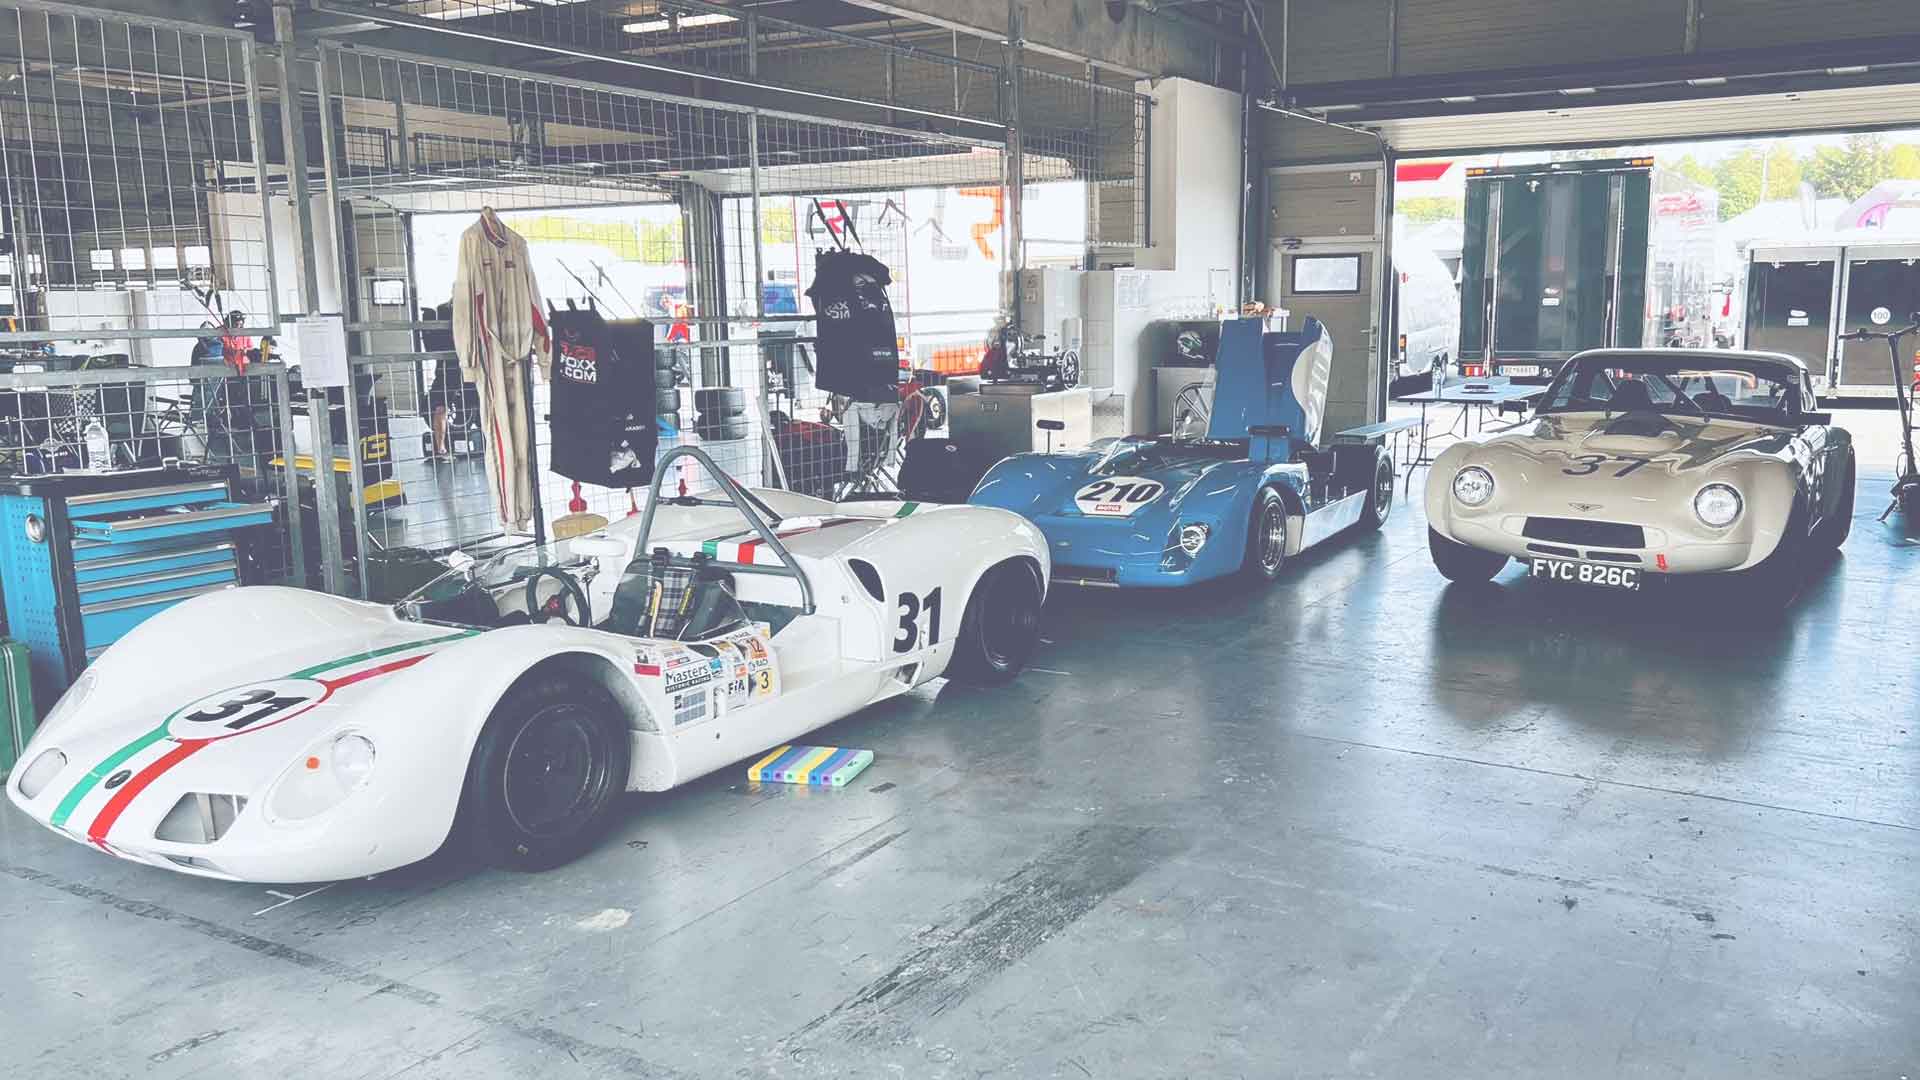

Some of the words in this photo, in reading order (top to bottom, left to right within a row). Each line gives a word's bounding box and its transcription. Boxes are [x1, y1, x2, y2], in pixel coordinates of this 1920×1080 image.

[1873, 312, 1889, 320] 100
[1562, 455, 1650, 477] 37
[1077, 481, 1163, 503] 210
[1533, 559, 1574, 579] FYC
[1578, 565, 1636, 588] 826C
[892, 586, 942, 653] 31
[665, 665, 709, 685] Masters
[761, 671, 769, 689] 3
[184, 689, 311, 730] 31
